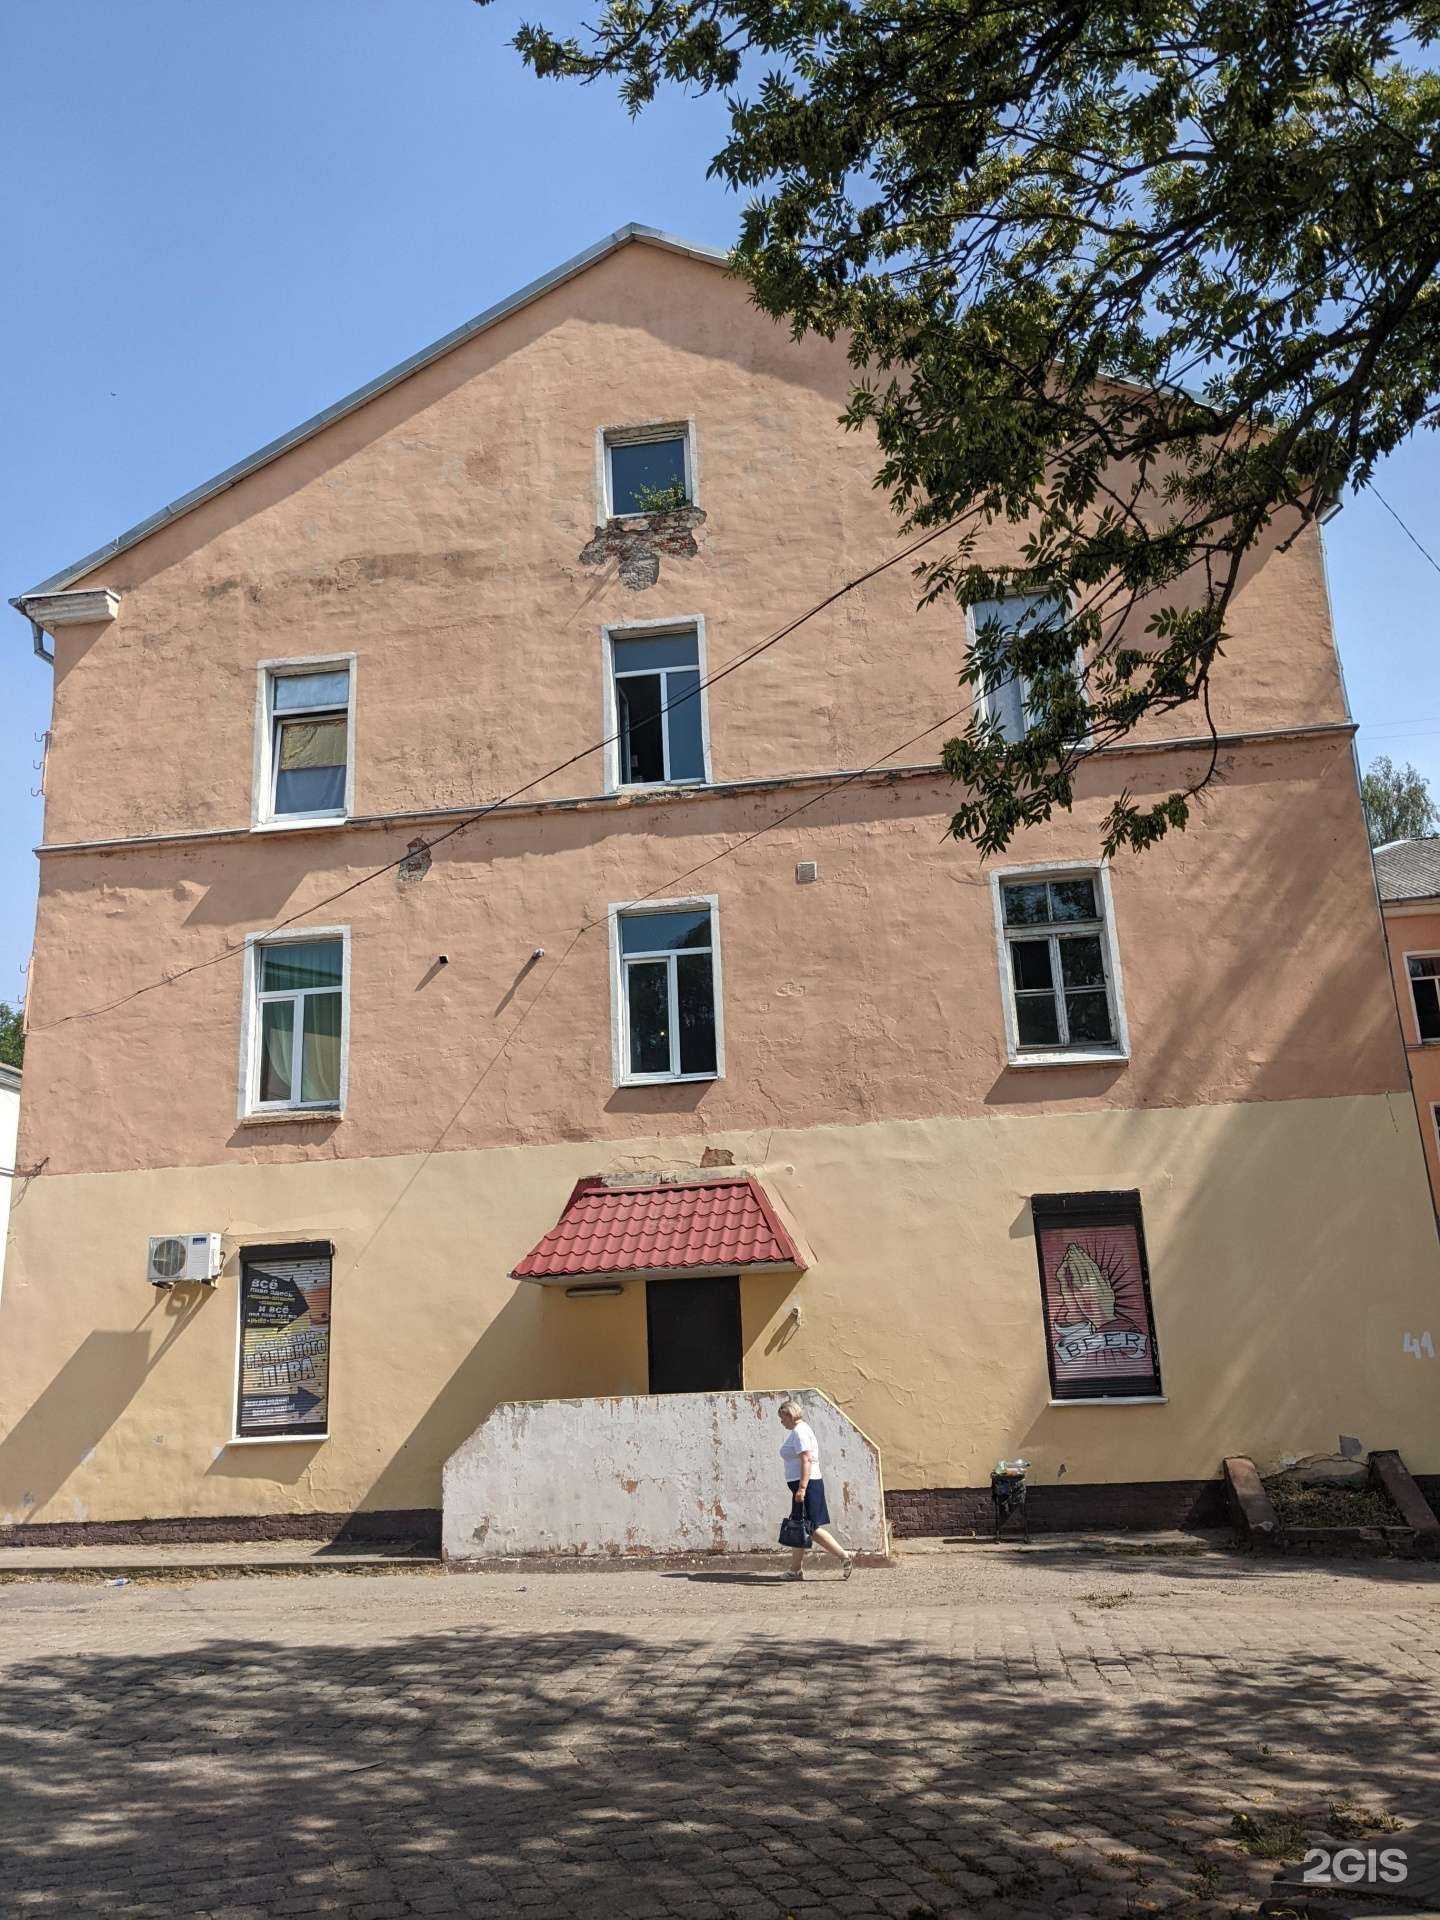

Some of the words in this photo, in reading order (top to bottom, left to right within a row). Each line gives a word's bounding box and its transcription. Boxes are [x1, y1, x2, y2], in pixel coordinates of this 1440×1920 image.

[245, 1339, 326, 1369] РАЗЛИВНОГО
[1065, 1333, 1140, 1357] BEER
[262, 1357, 315, 1387] ПИВА
